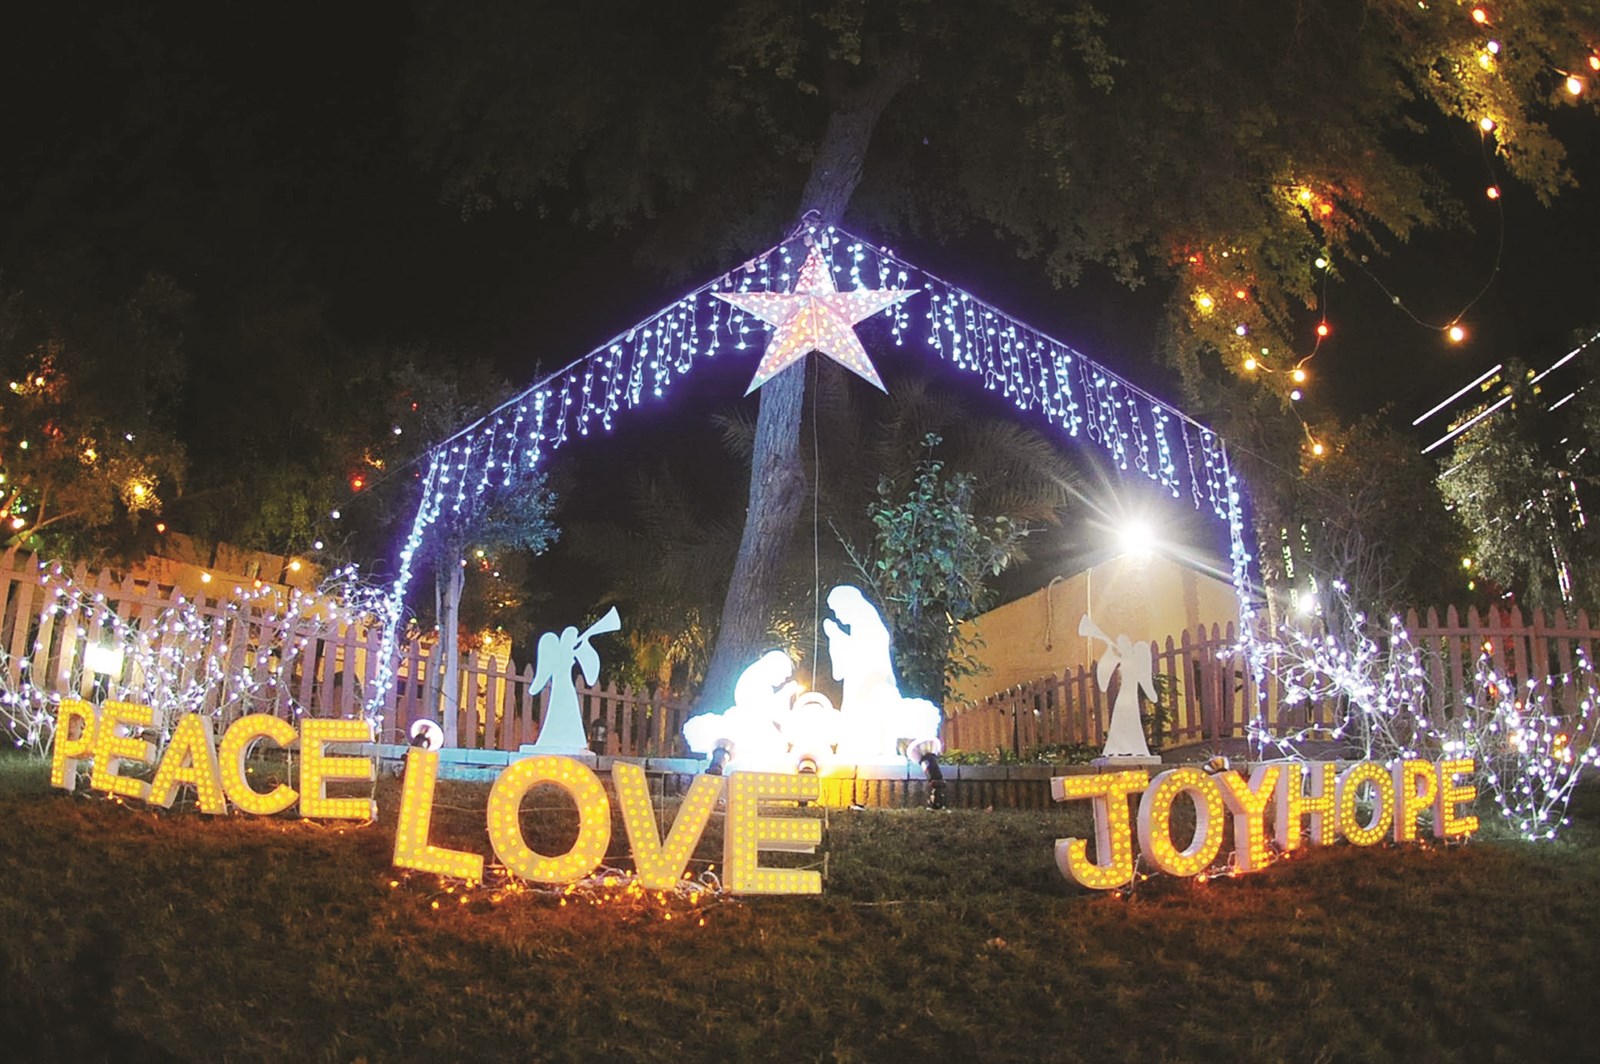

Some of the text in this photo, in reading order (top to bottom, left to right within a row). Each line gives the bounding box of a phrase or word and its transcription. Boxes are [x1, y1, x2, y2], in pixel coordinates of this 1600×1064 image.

[51, 699, 376, 820] PEACE
[1279, 759, 1479, 851] HOPE
[393, 747, 822, 895] LOVE
[1051, 766, 1281, 890] JOY
